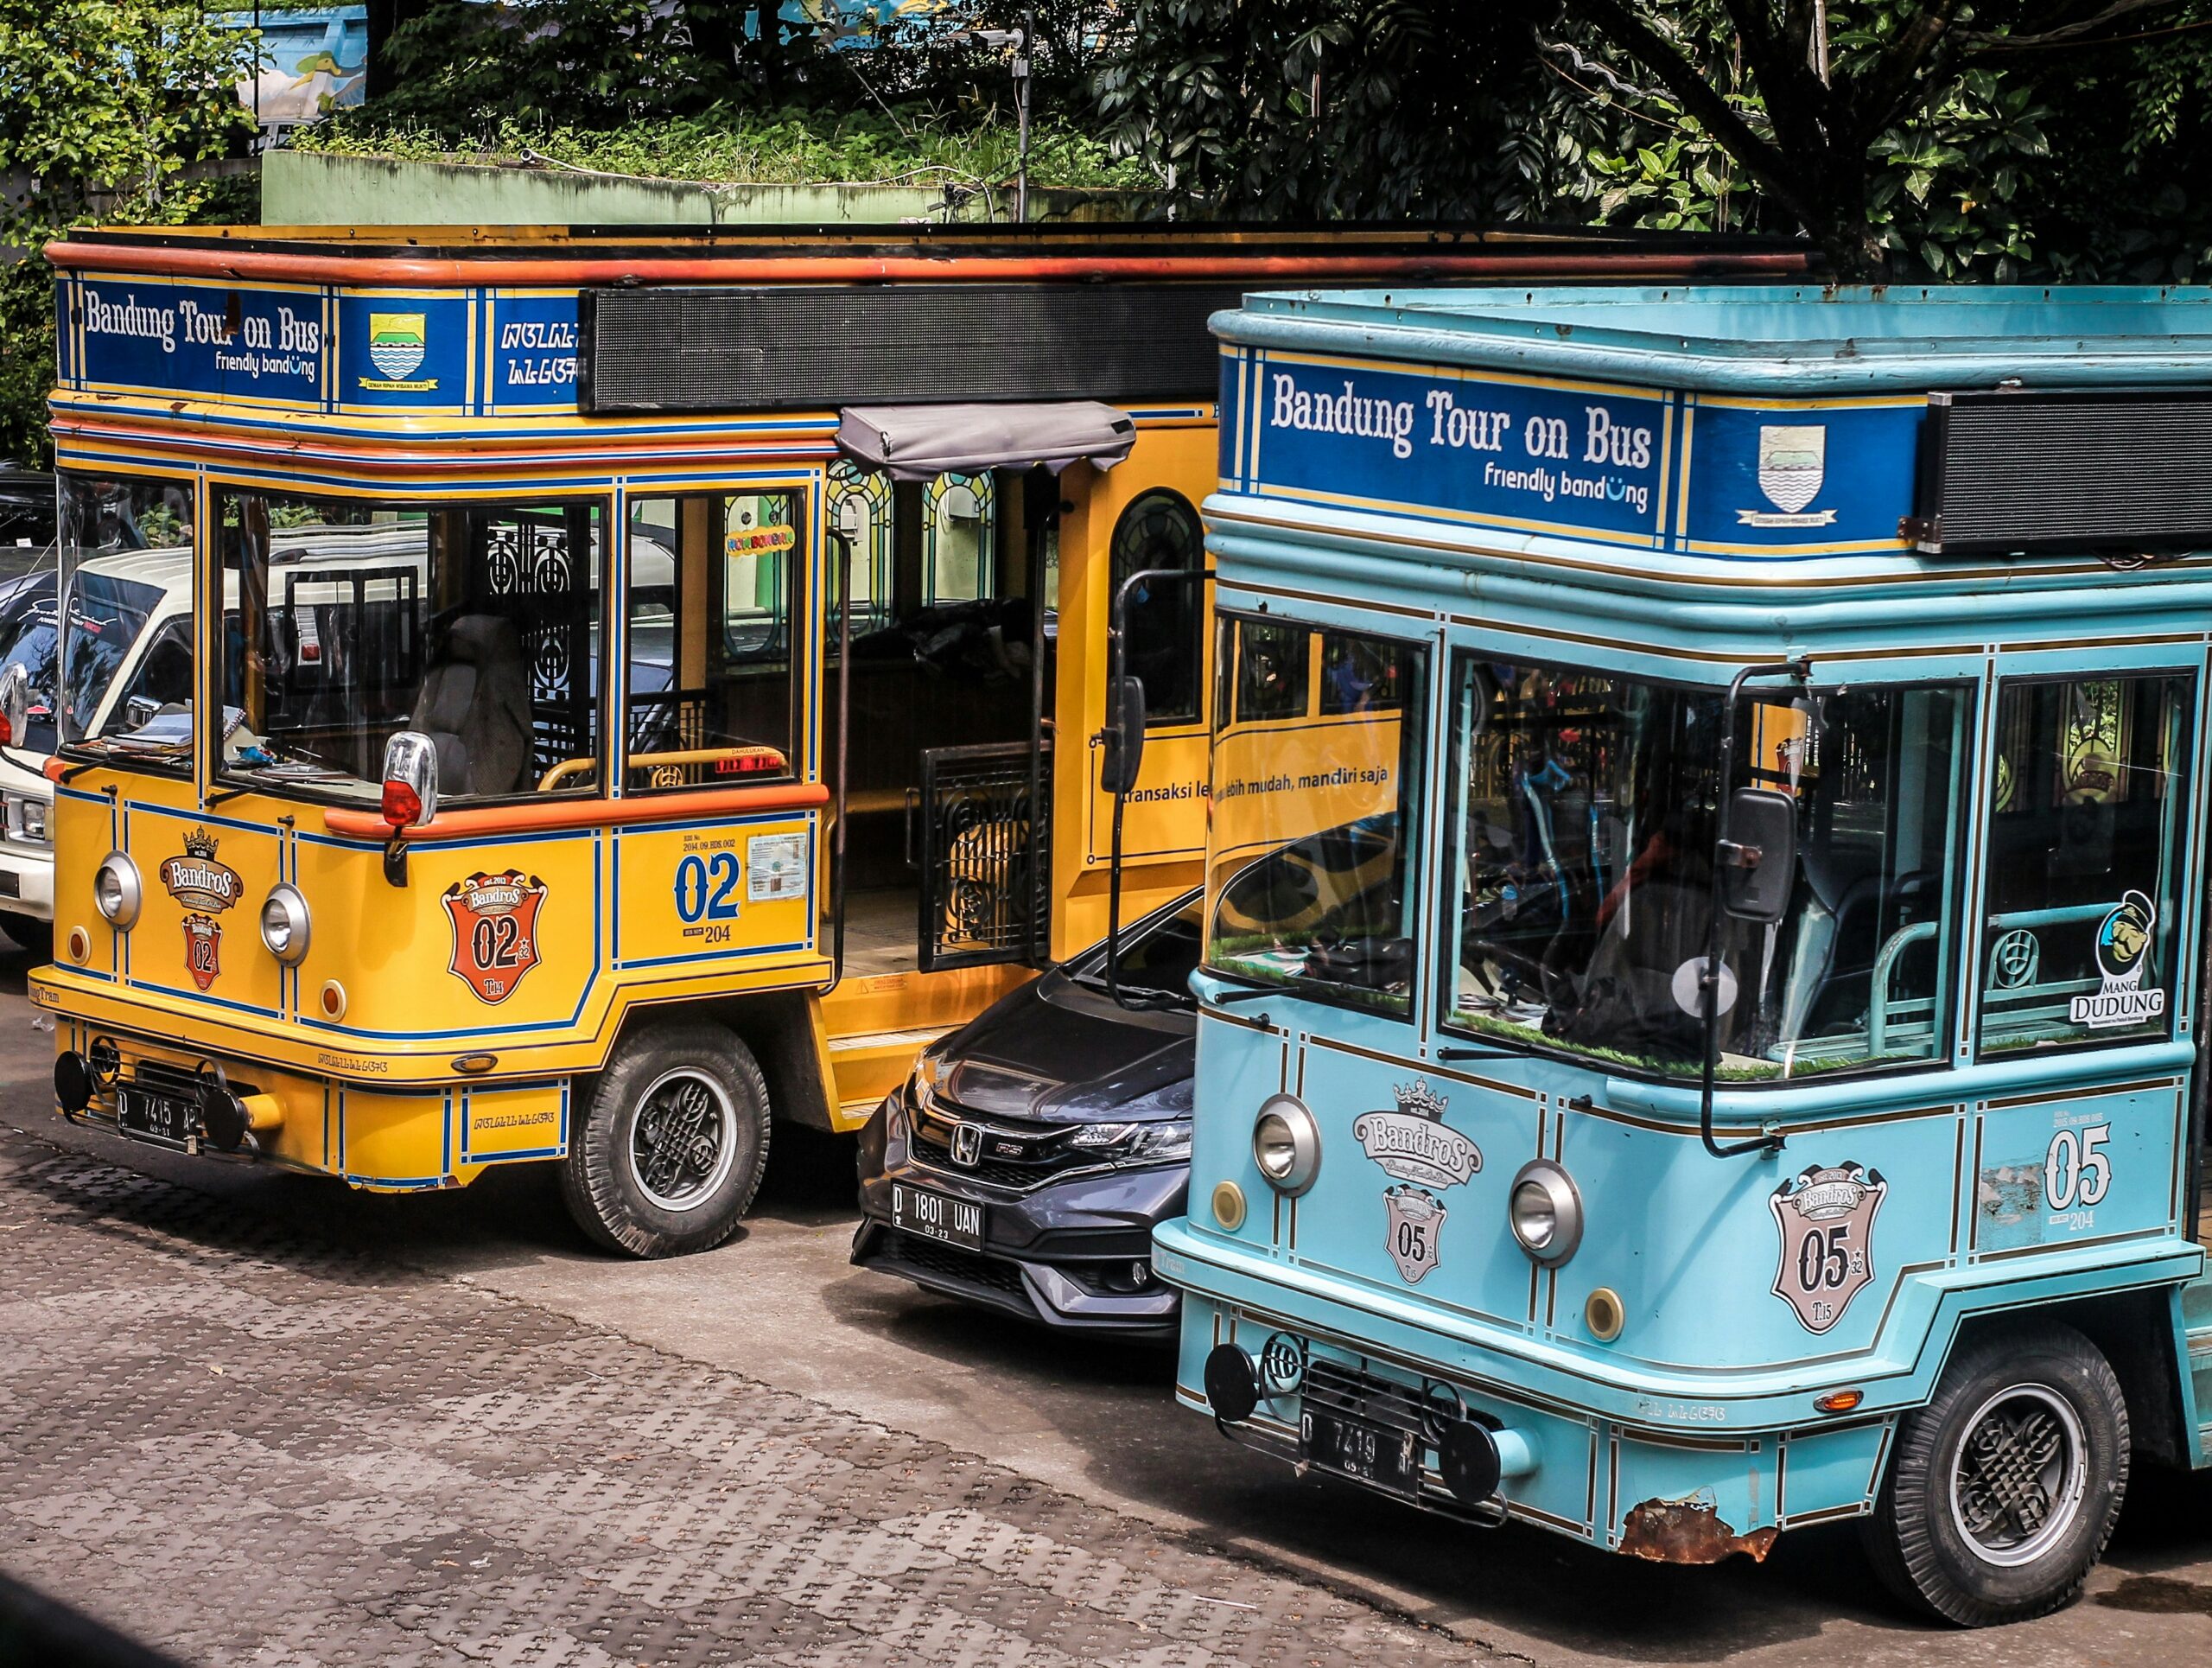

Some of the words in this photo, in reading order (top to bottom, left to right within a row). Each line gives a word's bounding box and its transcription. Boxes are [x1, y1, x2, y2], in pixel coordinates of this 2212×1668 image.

[86, 290, 176, 353] Bandung
[244, 317, 272, 349] on
[278, 307, 320, 353] Bus
[216, 351, 259, 379] friendly
[1271, 373, 1414, 458] Bandung
[1427, 390, 1510, 453] Tour
[1524, 416, 1569, 460] on
[1583, 406, 1652, 469] Bus
[1484, 462, 1555, 502] friendly
[1299, 766, 1357, 789] mandiri
[1359, 767, 1389, 784] saja
[170, 861, 233, 899] Bandros
[674, 851, 741, 924] 02
[469, 888, 521, 908] Bandros
[472, 916, 518, 970] 02
[705, 925, 731, 943] 204
[193, 940, 213, 972] 02
[518, 947, 530, 959] 32
[2102, 981, 2138, 994] MANG
[2075, 992, 2162, 1020] DUDUNG
[119, 1092, 128, 1115] D
[995, 1143, 1023, 1156] RS
[1370, 1117, 1467, 1171] Bandros
[2044, 1121, 2112, 1210] 05
[894, 1187, 903, 1213] D
[914, 1193, 943, 1226] 1801
[954, 1203, 980, 1236] UAN
[1803, 1185, 1856, 1211] Bandros
[2069, 1211, 2094, 1231] 204
[1397, 1220, 1426, 1262] 05
[1797, 1222, 1851, 1293] 05
[1851, 1261, 1863, 1274] 32
[1302, 1413, 1313, 1442] D
